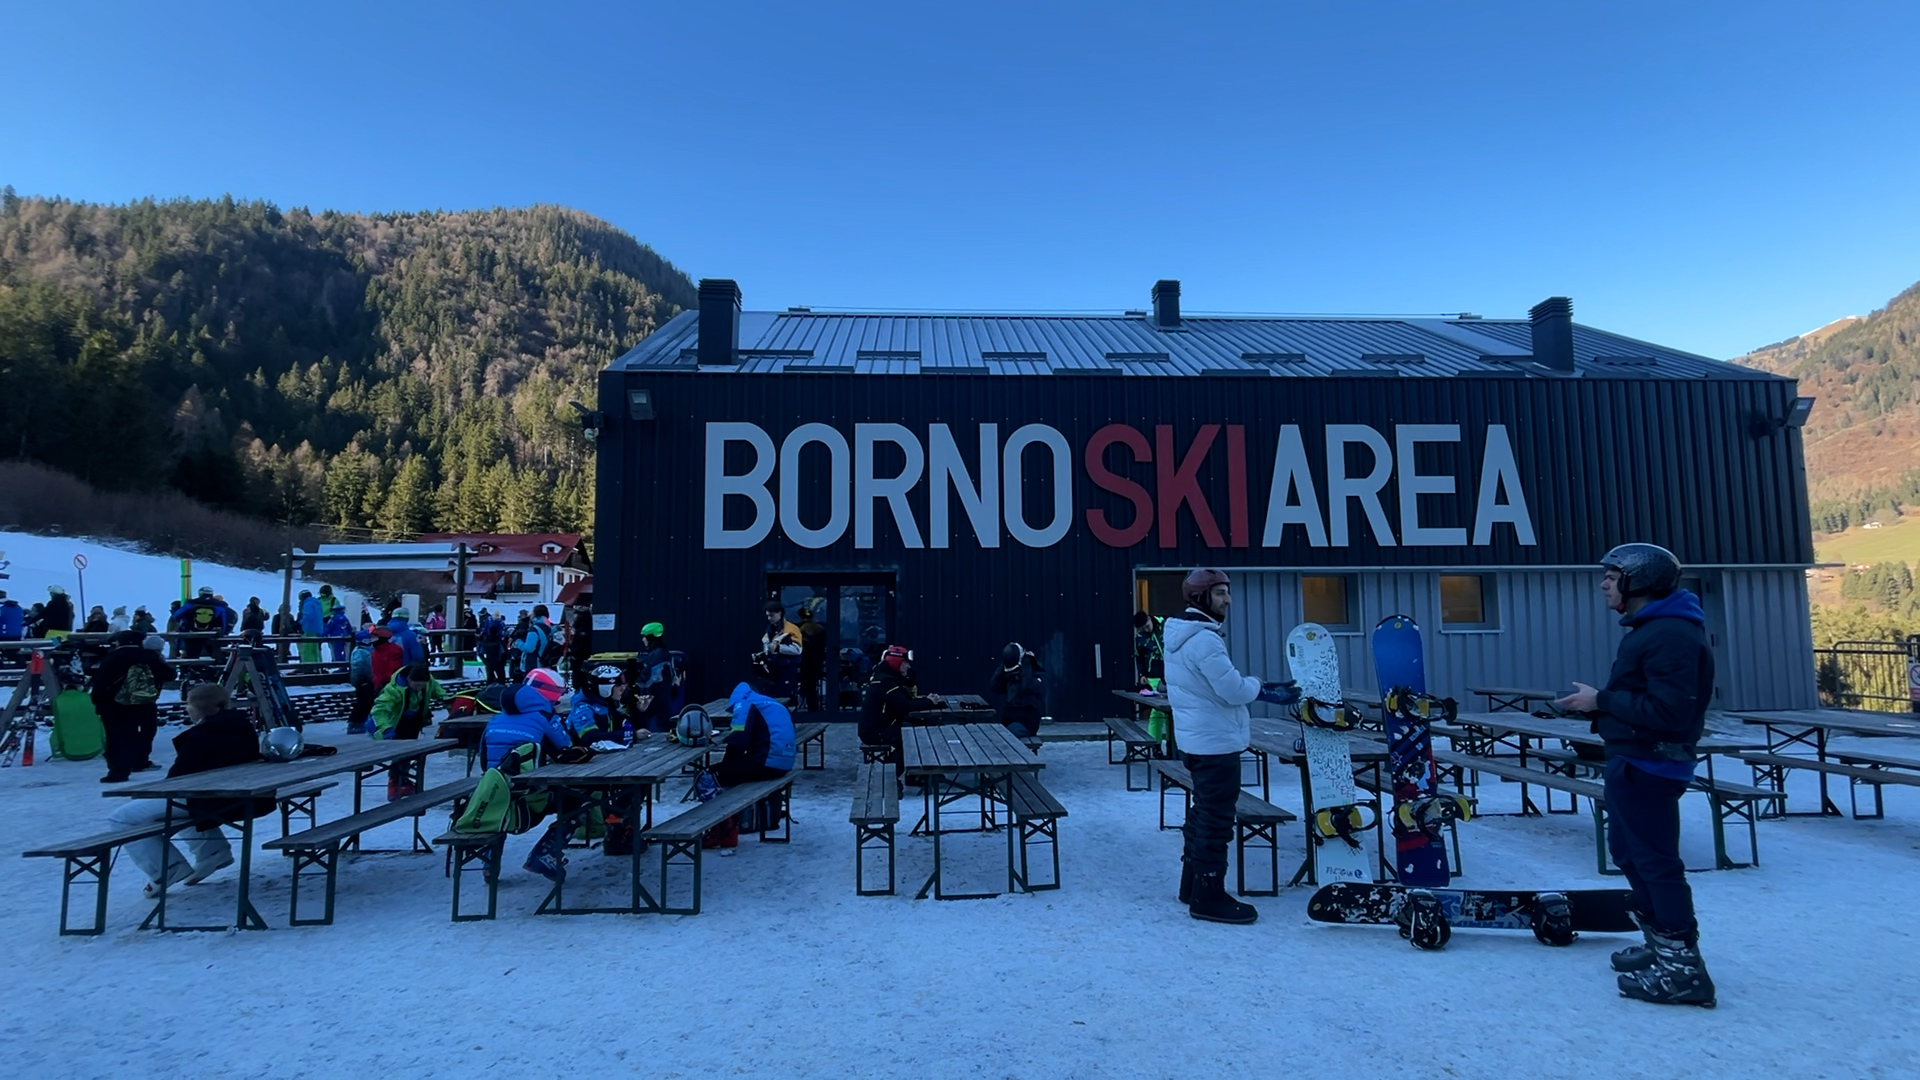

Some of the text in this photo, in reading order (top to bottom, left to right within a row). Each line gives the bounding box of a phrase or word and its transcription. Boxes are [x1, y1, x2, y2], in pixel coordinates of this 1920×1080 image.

[704, 422, 1538, 549] BORNO SKI AREA
